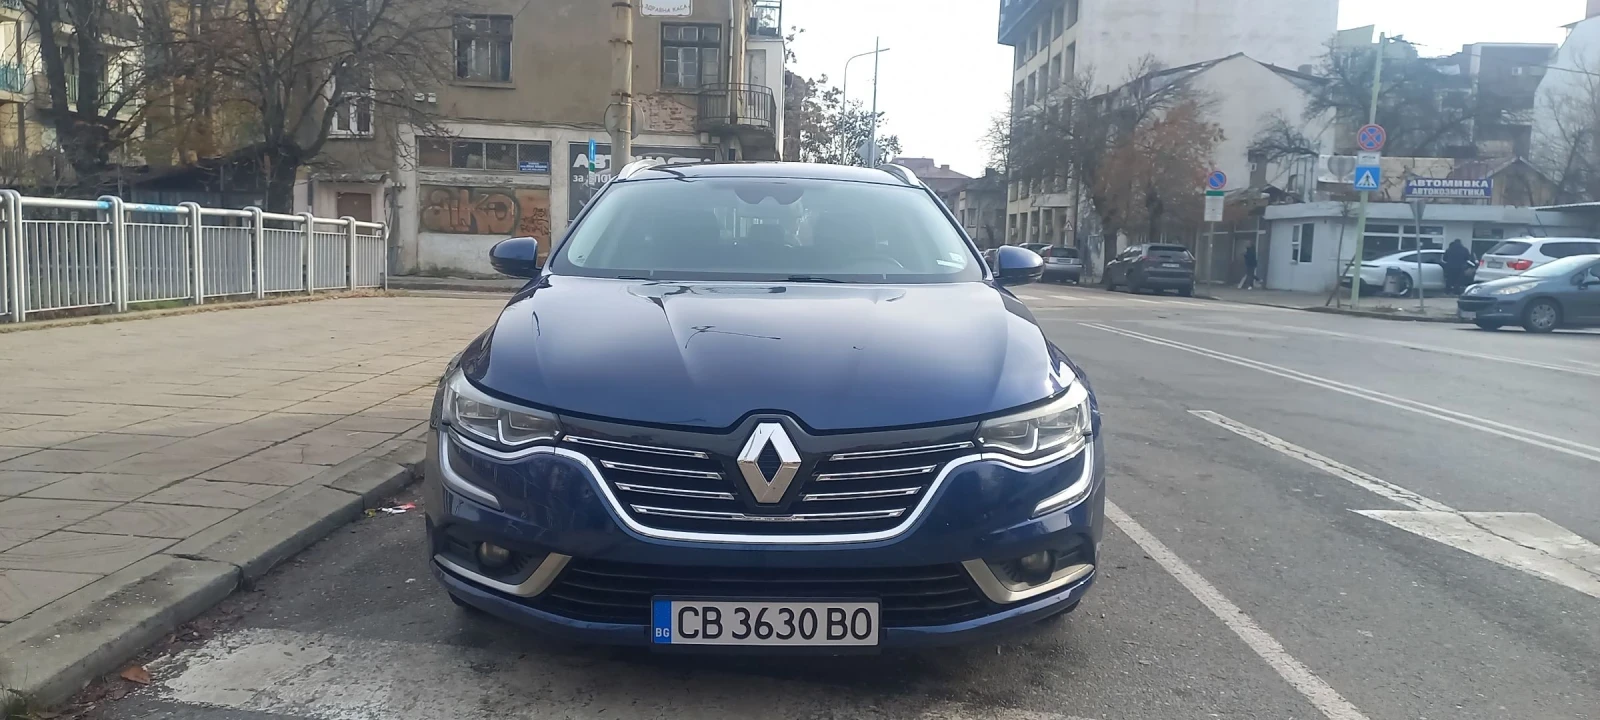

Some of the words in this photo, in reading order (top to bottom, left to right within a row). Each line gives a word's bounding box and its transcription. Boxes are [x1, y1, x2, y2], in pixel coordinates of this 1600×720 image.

[573, 174, 584, 182] за
[1409, 179, 1489, 188] АВТОМИВКА
[1412, 187, 1485, 196] АВТОКОЗМЕТИКА
[677, 606, 723, 639] CB
[732, 607, 818, 640] 3630
[826, 607, 872, 640] BO
[655, 627, 670, 638] BG
